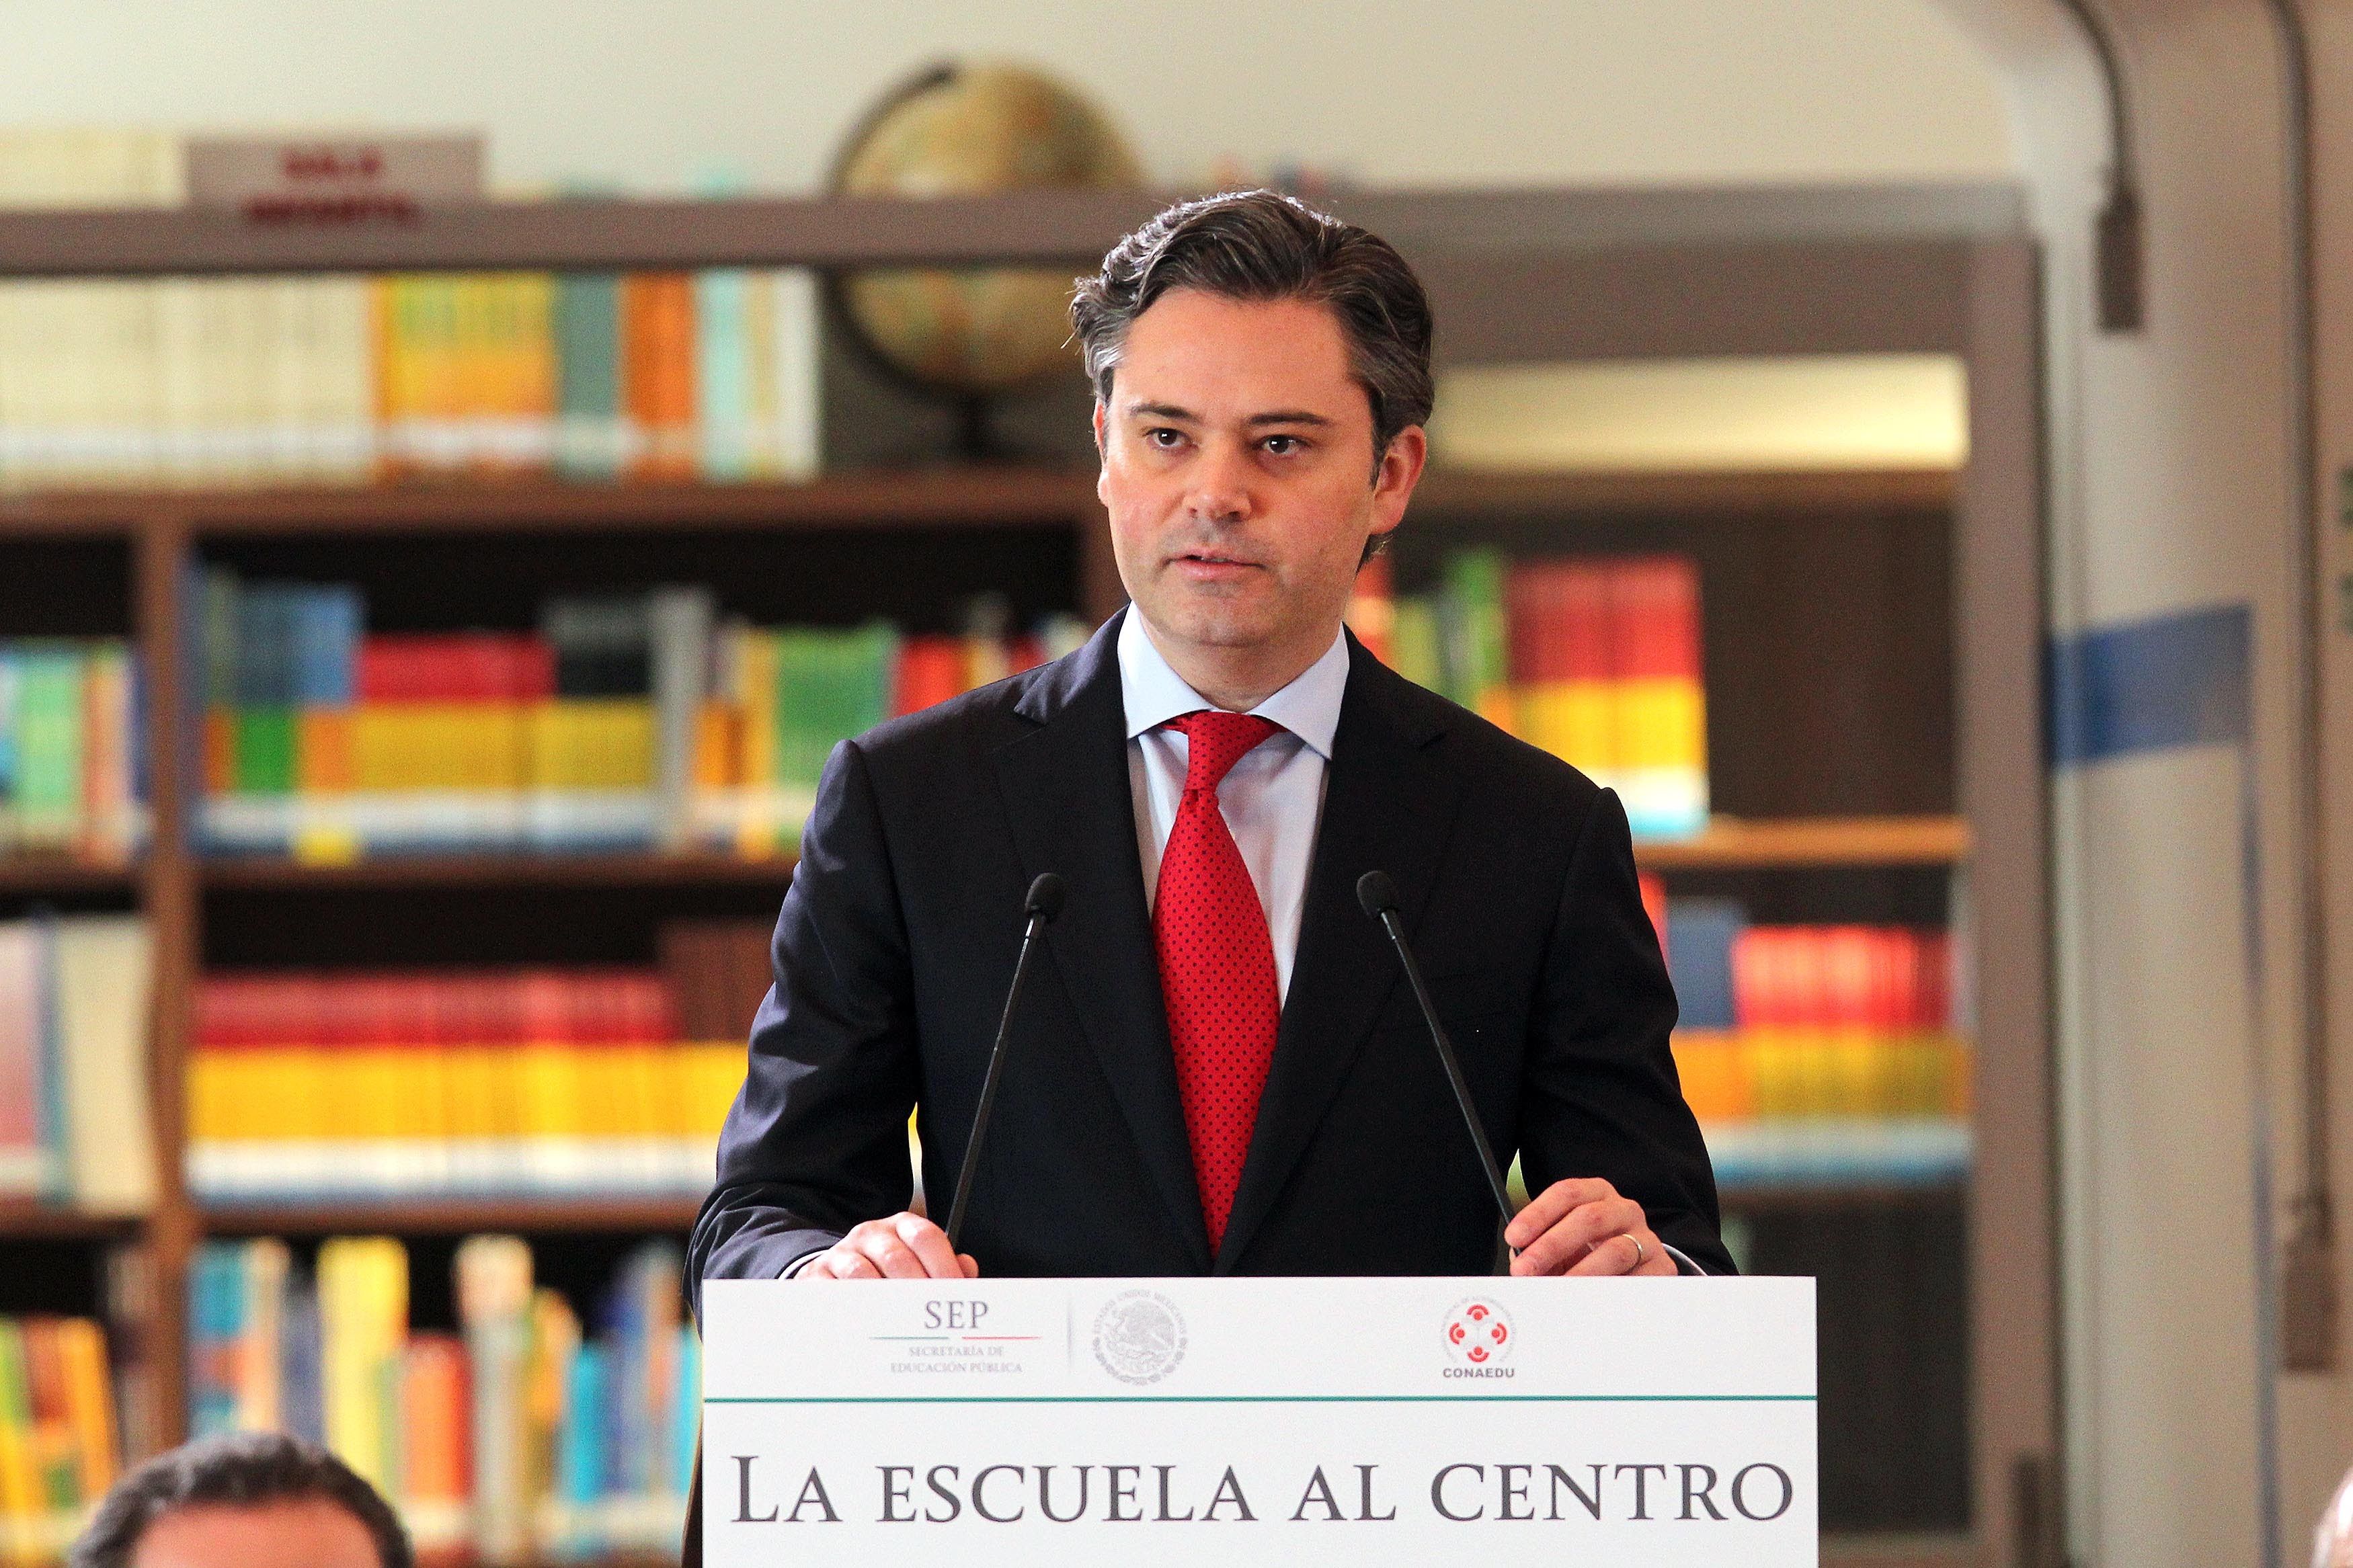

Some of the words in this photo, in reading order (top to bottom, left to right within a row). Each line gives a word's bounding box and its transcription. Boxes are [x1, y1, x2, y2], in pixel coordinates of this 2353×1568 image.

[924, 1301, 989, 1329] SEP
[909, 1346, 984, 1356] SECRETARÍA
[988, 1347, 1004, 1356] DE
[891, 1361, 966, 1372] EDUCACIÓN
[970, 1361, 1022, 1372] PÚBLICA
[1443, 1368, 1515, 1378] CONAEDU
[731, 1455, 844, 1523] LA
[875, 1464, 1259, 1524] ESCUELA
[1288, 1464, 1397, 1522] AL
[1430, 1462, 1794, 1523] CENTRO
